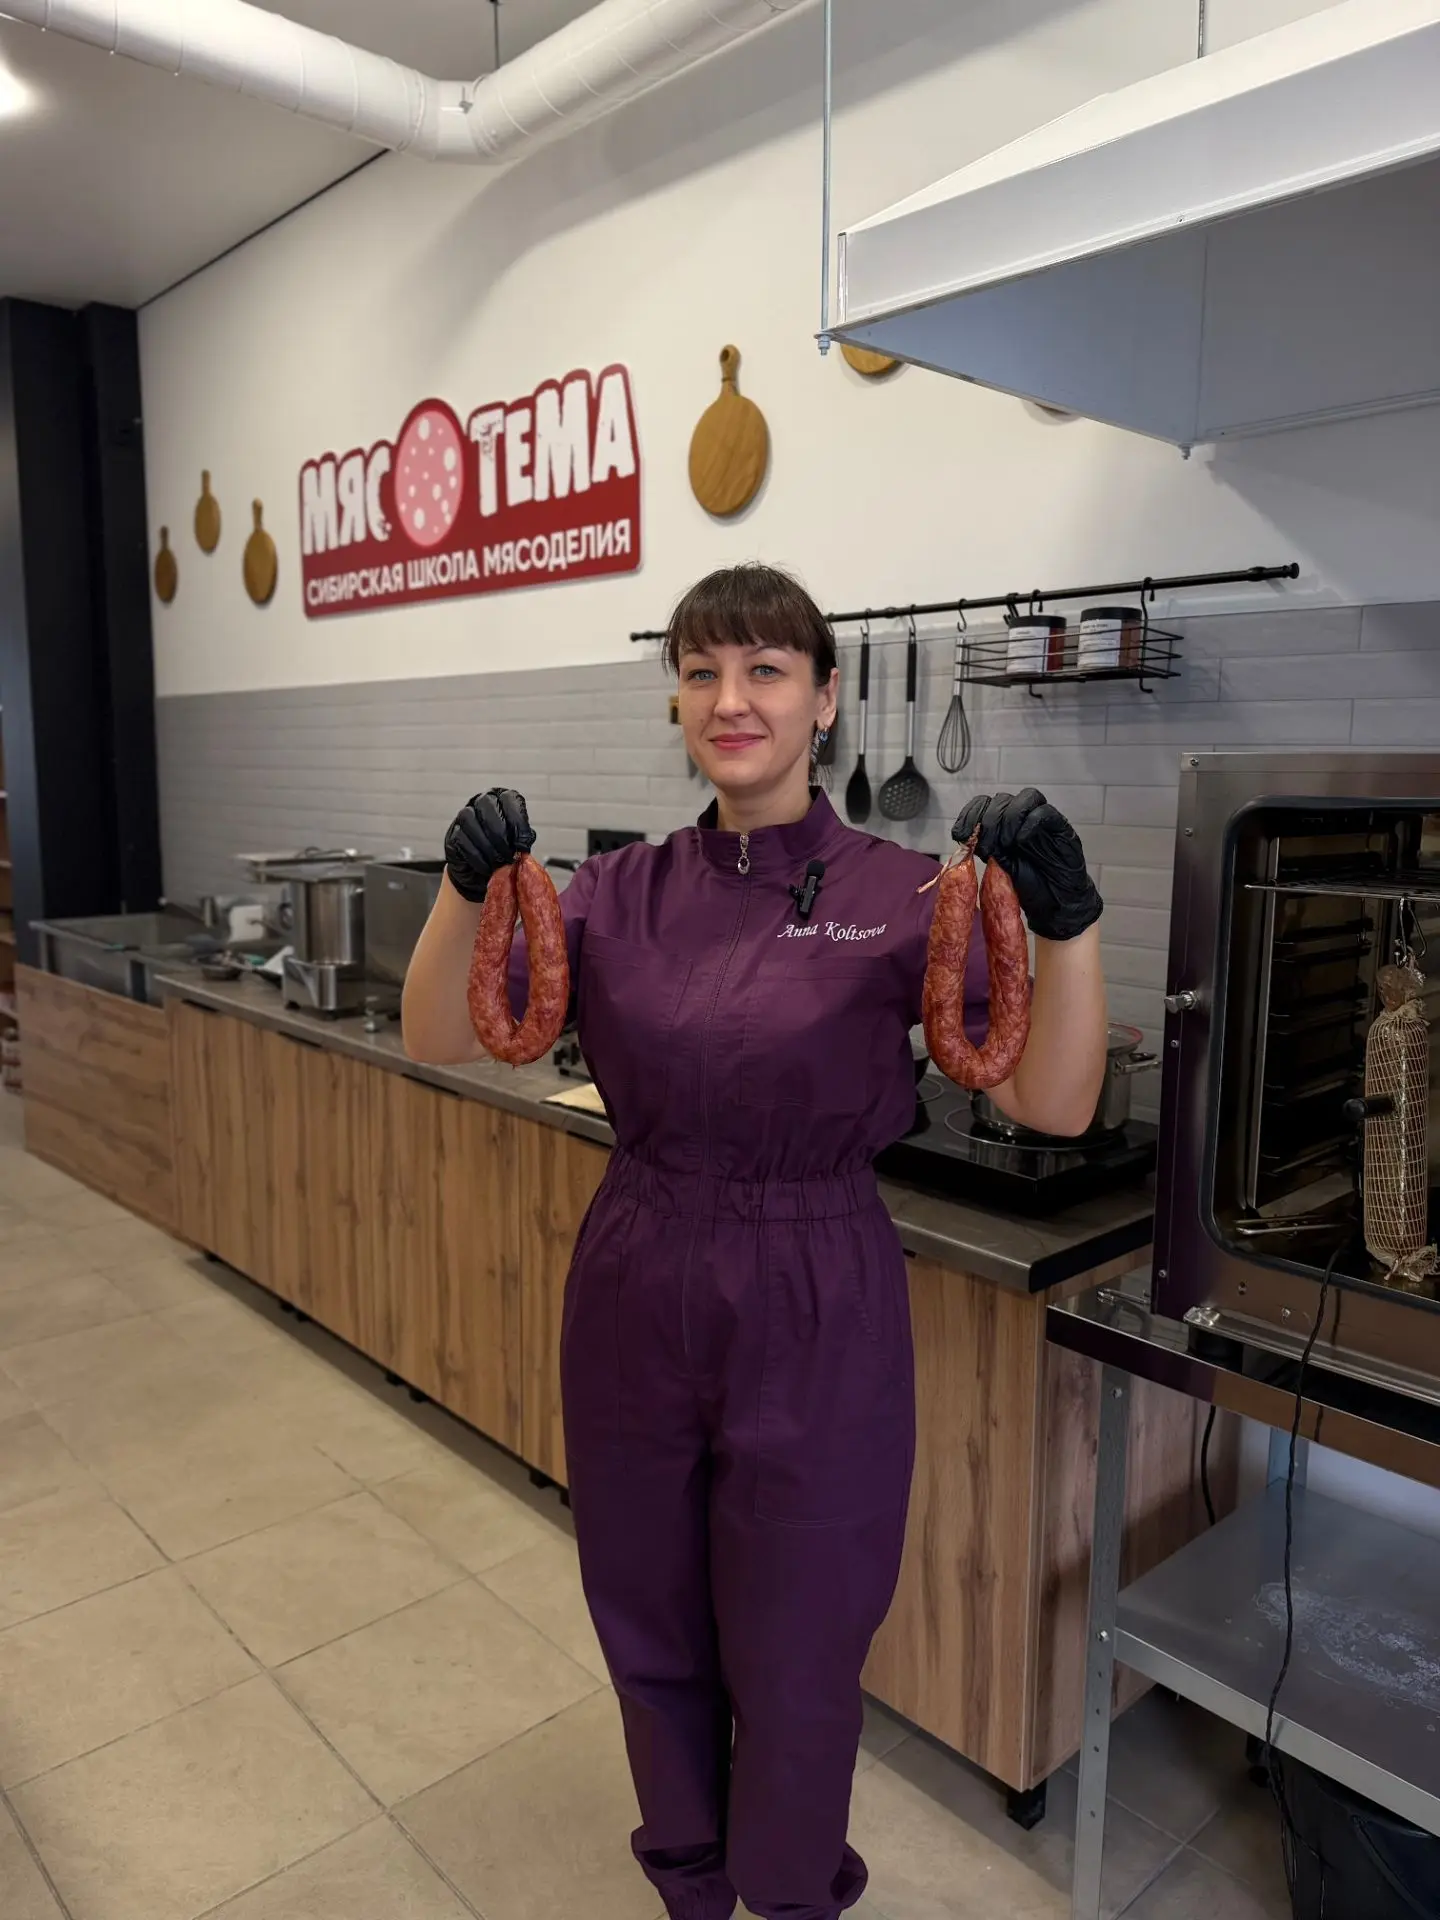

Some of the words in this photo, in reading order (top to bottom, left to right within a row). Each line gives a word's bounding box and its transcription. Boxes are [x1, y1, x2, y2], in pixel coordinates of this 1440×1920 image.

[307, 563, 402, 606] СИБИРСКАЯ
[407, 549, 480, 589] ШКОЛА
[483, 518, 632, 578] МЯСОДЕЛИЯ
[777, 923, 819, 938] Anna
[824, 921, 887, 942] Koltsova
